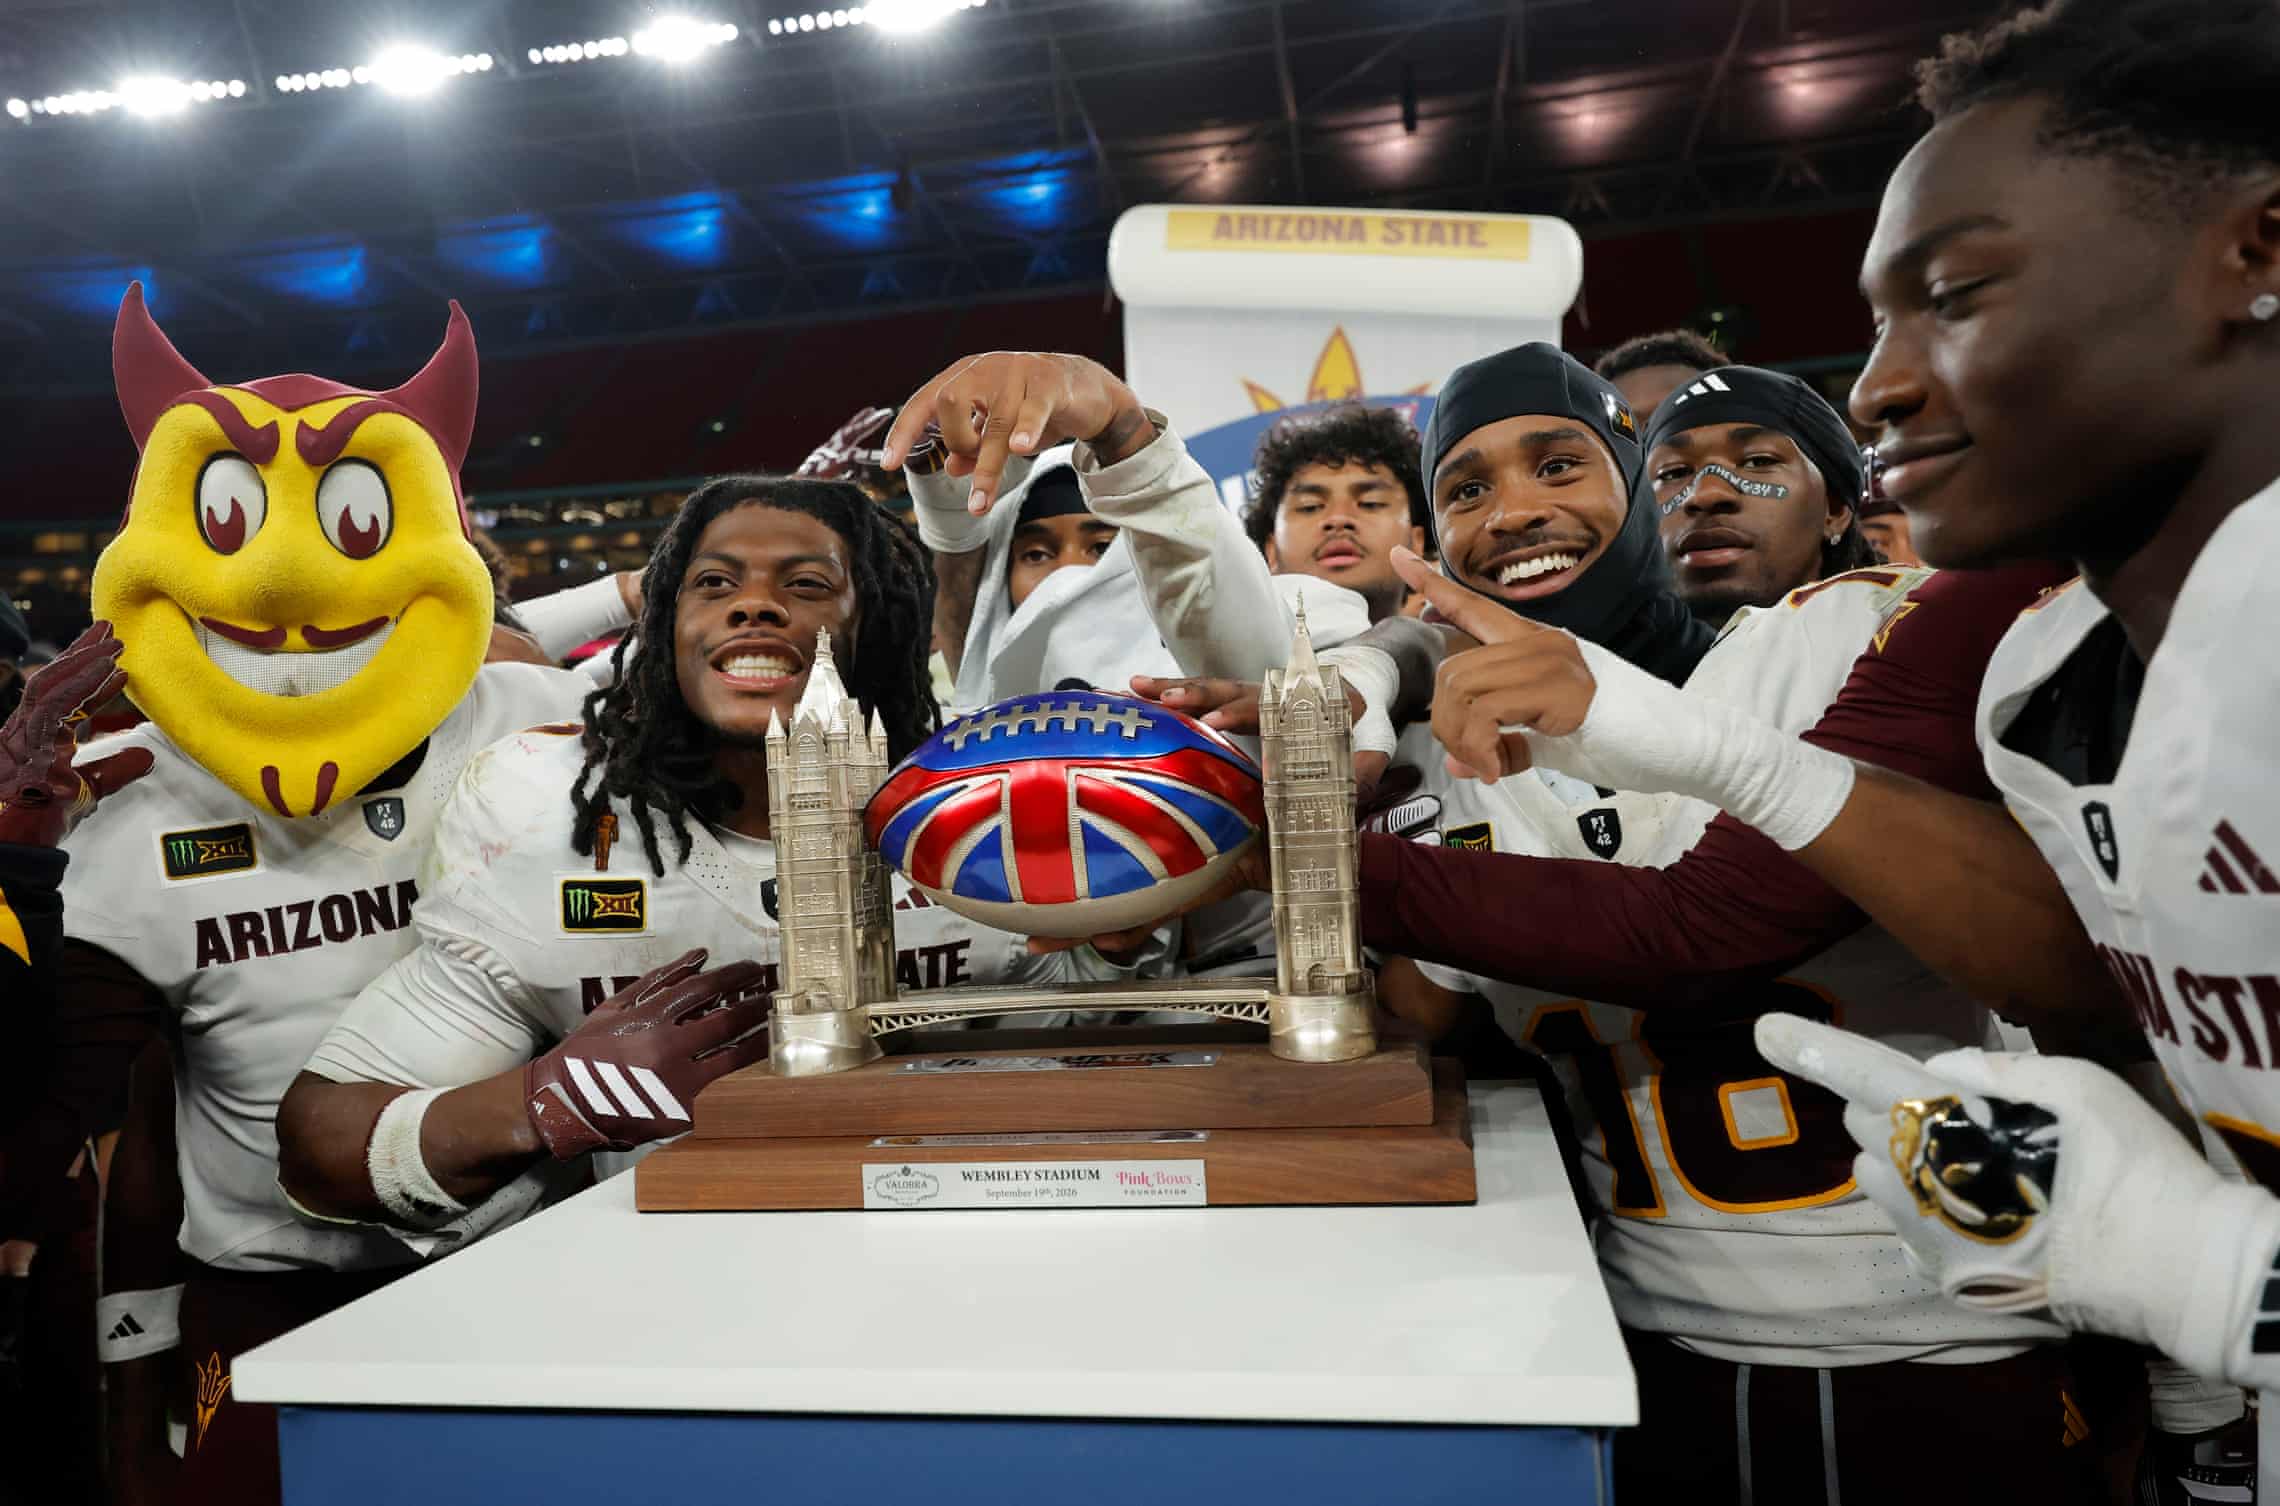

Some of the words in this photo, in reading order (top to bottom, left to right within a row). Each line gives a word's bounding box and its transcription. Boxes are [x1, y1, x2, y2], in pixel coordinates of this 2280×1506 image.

[1212, 212, 1366, 242] ARIZONA
[1383, 218, 1488, 249] STATE
[195, 879, 420, 969] ARIZONA
[896, 938, 972, 991] ATE
[961, 1169, 1032, 1183] WEMBLEY
[1033, 1167, 1100, 1181] STADIUM
[1115, 1170, 1154, 1187] Pink
[1154, 1170, 1192, 1185] Bows
[985, 1187, 1032, 1200] September
[1055, 1186, 1078, 1198] 2026
